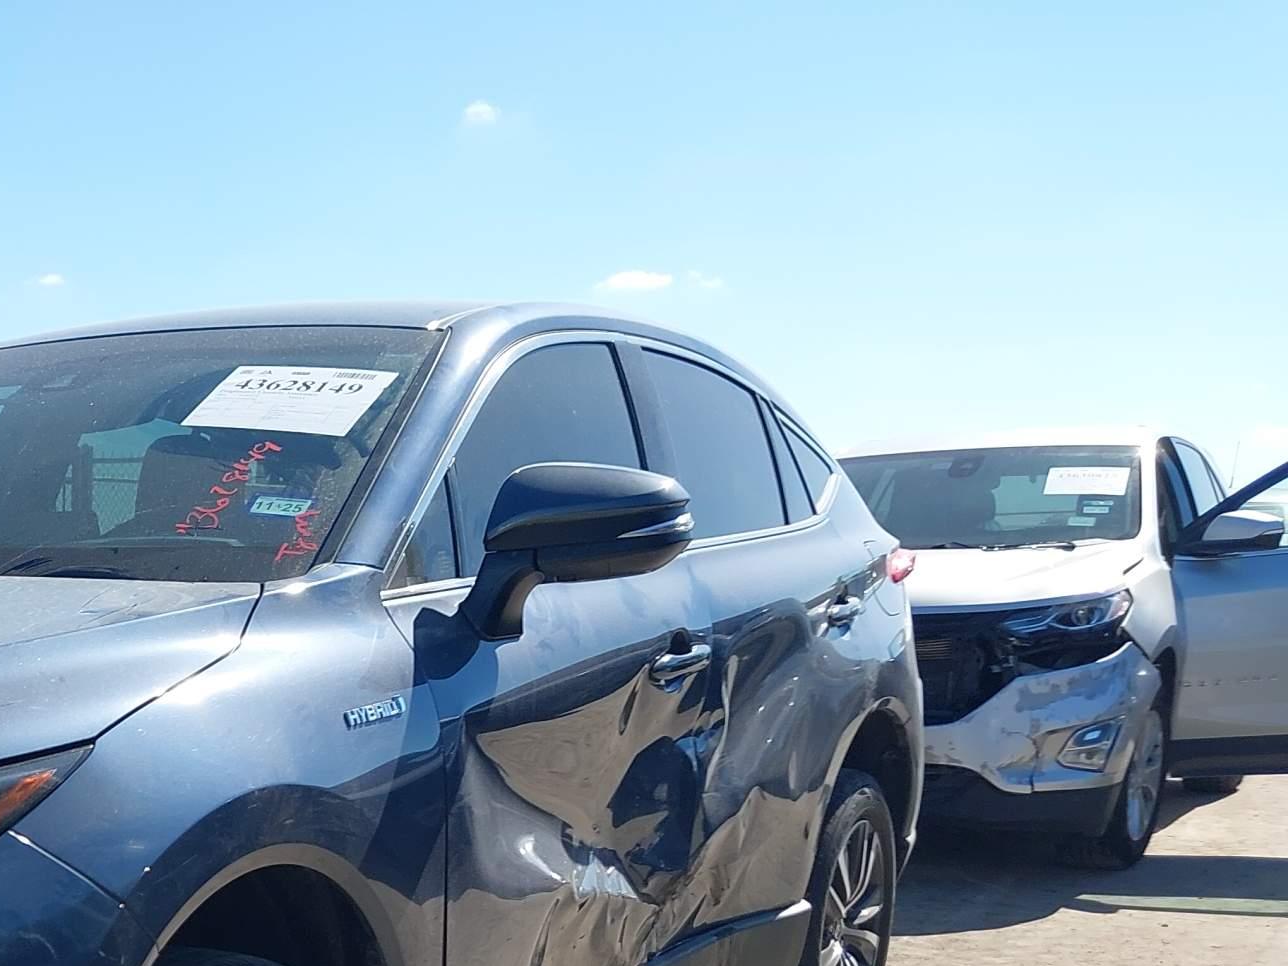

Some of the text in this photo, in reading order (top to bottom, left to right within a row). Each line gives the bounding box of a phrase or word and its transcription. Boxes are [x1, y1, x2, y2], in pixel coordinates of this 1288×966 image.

[234, 377, 364, 395] 43628149
[280, 503, 304, 513] 25
[348, 697, 403, 726] HYBRID
